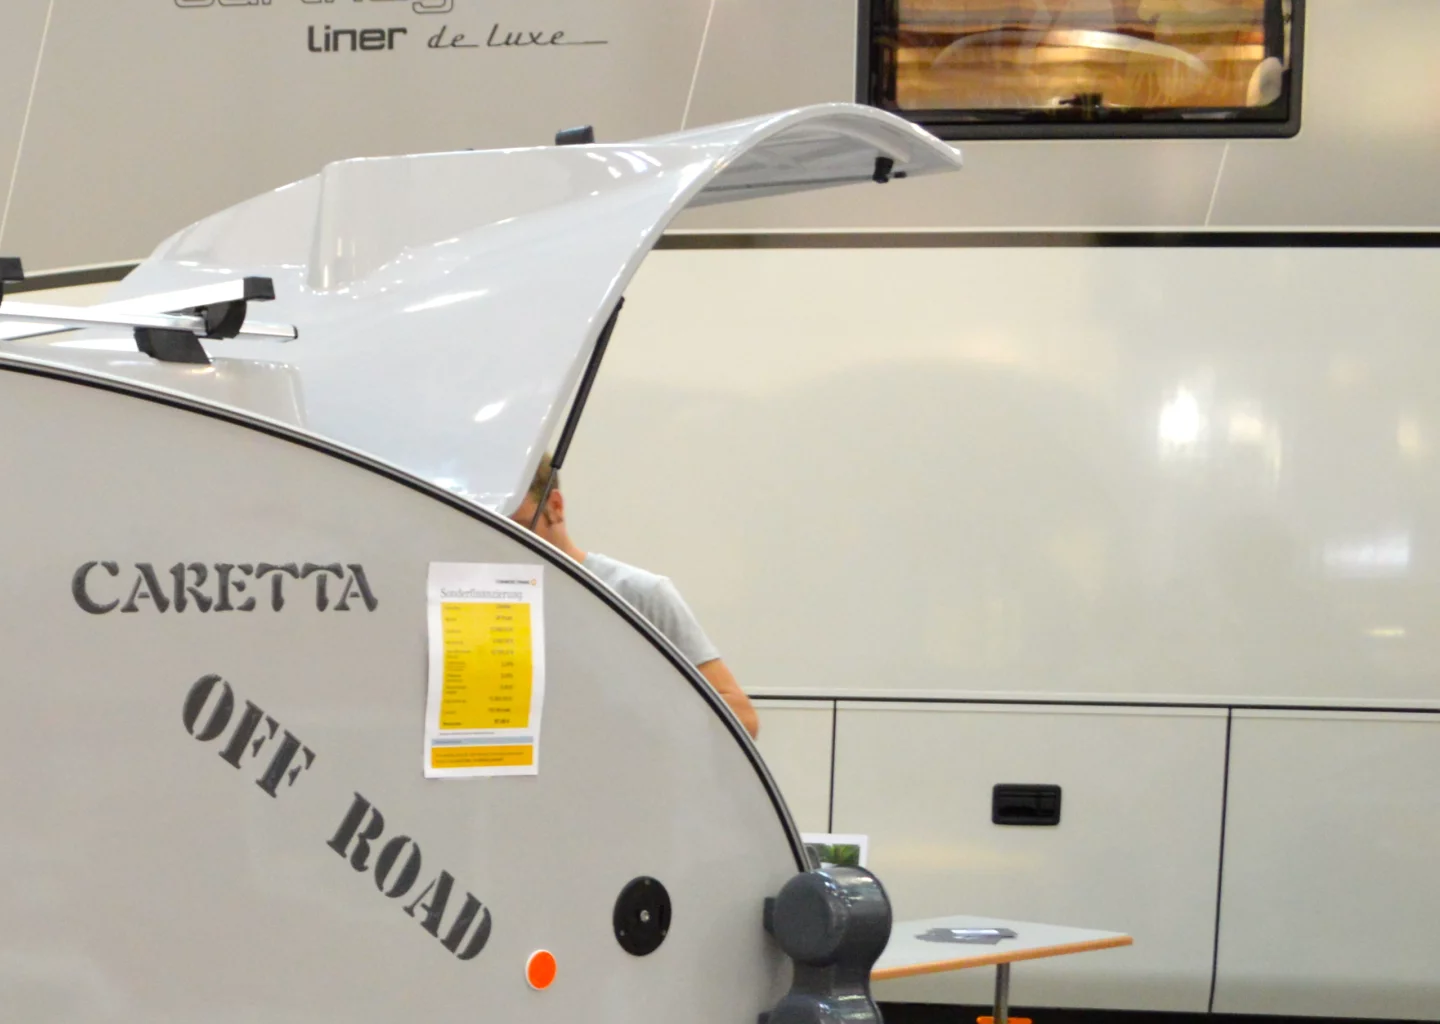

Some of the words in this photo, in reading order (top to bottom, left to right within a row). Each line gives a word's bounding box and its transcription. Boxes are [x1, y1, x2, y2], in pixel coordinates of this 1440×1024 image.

[427, 25, 479, 49] de
[486, 23, 608, 48] luxe
[71, 560, 379, 616] CARETTA
[182, 672, 316, 799] OFF
[325, 791, 493, 961] ROAD
